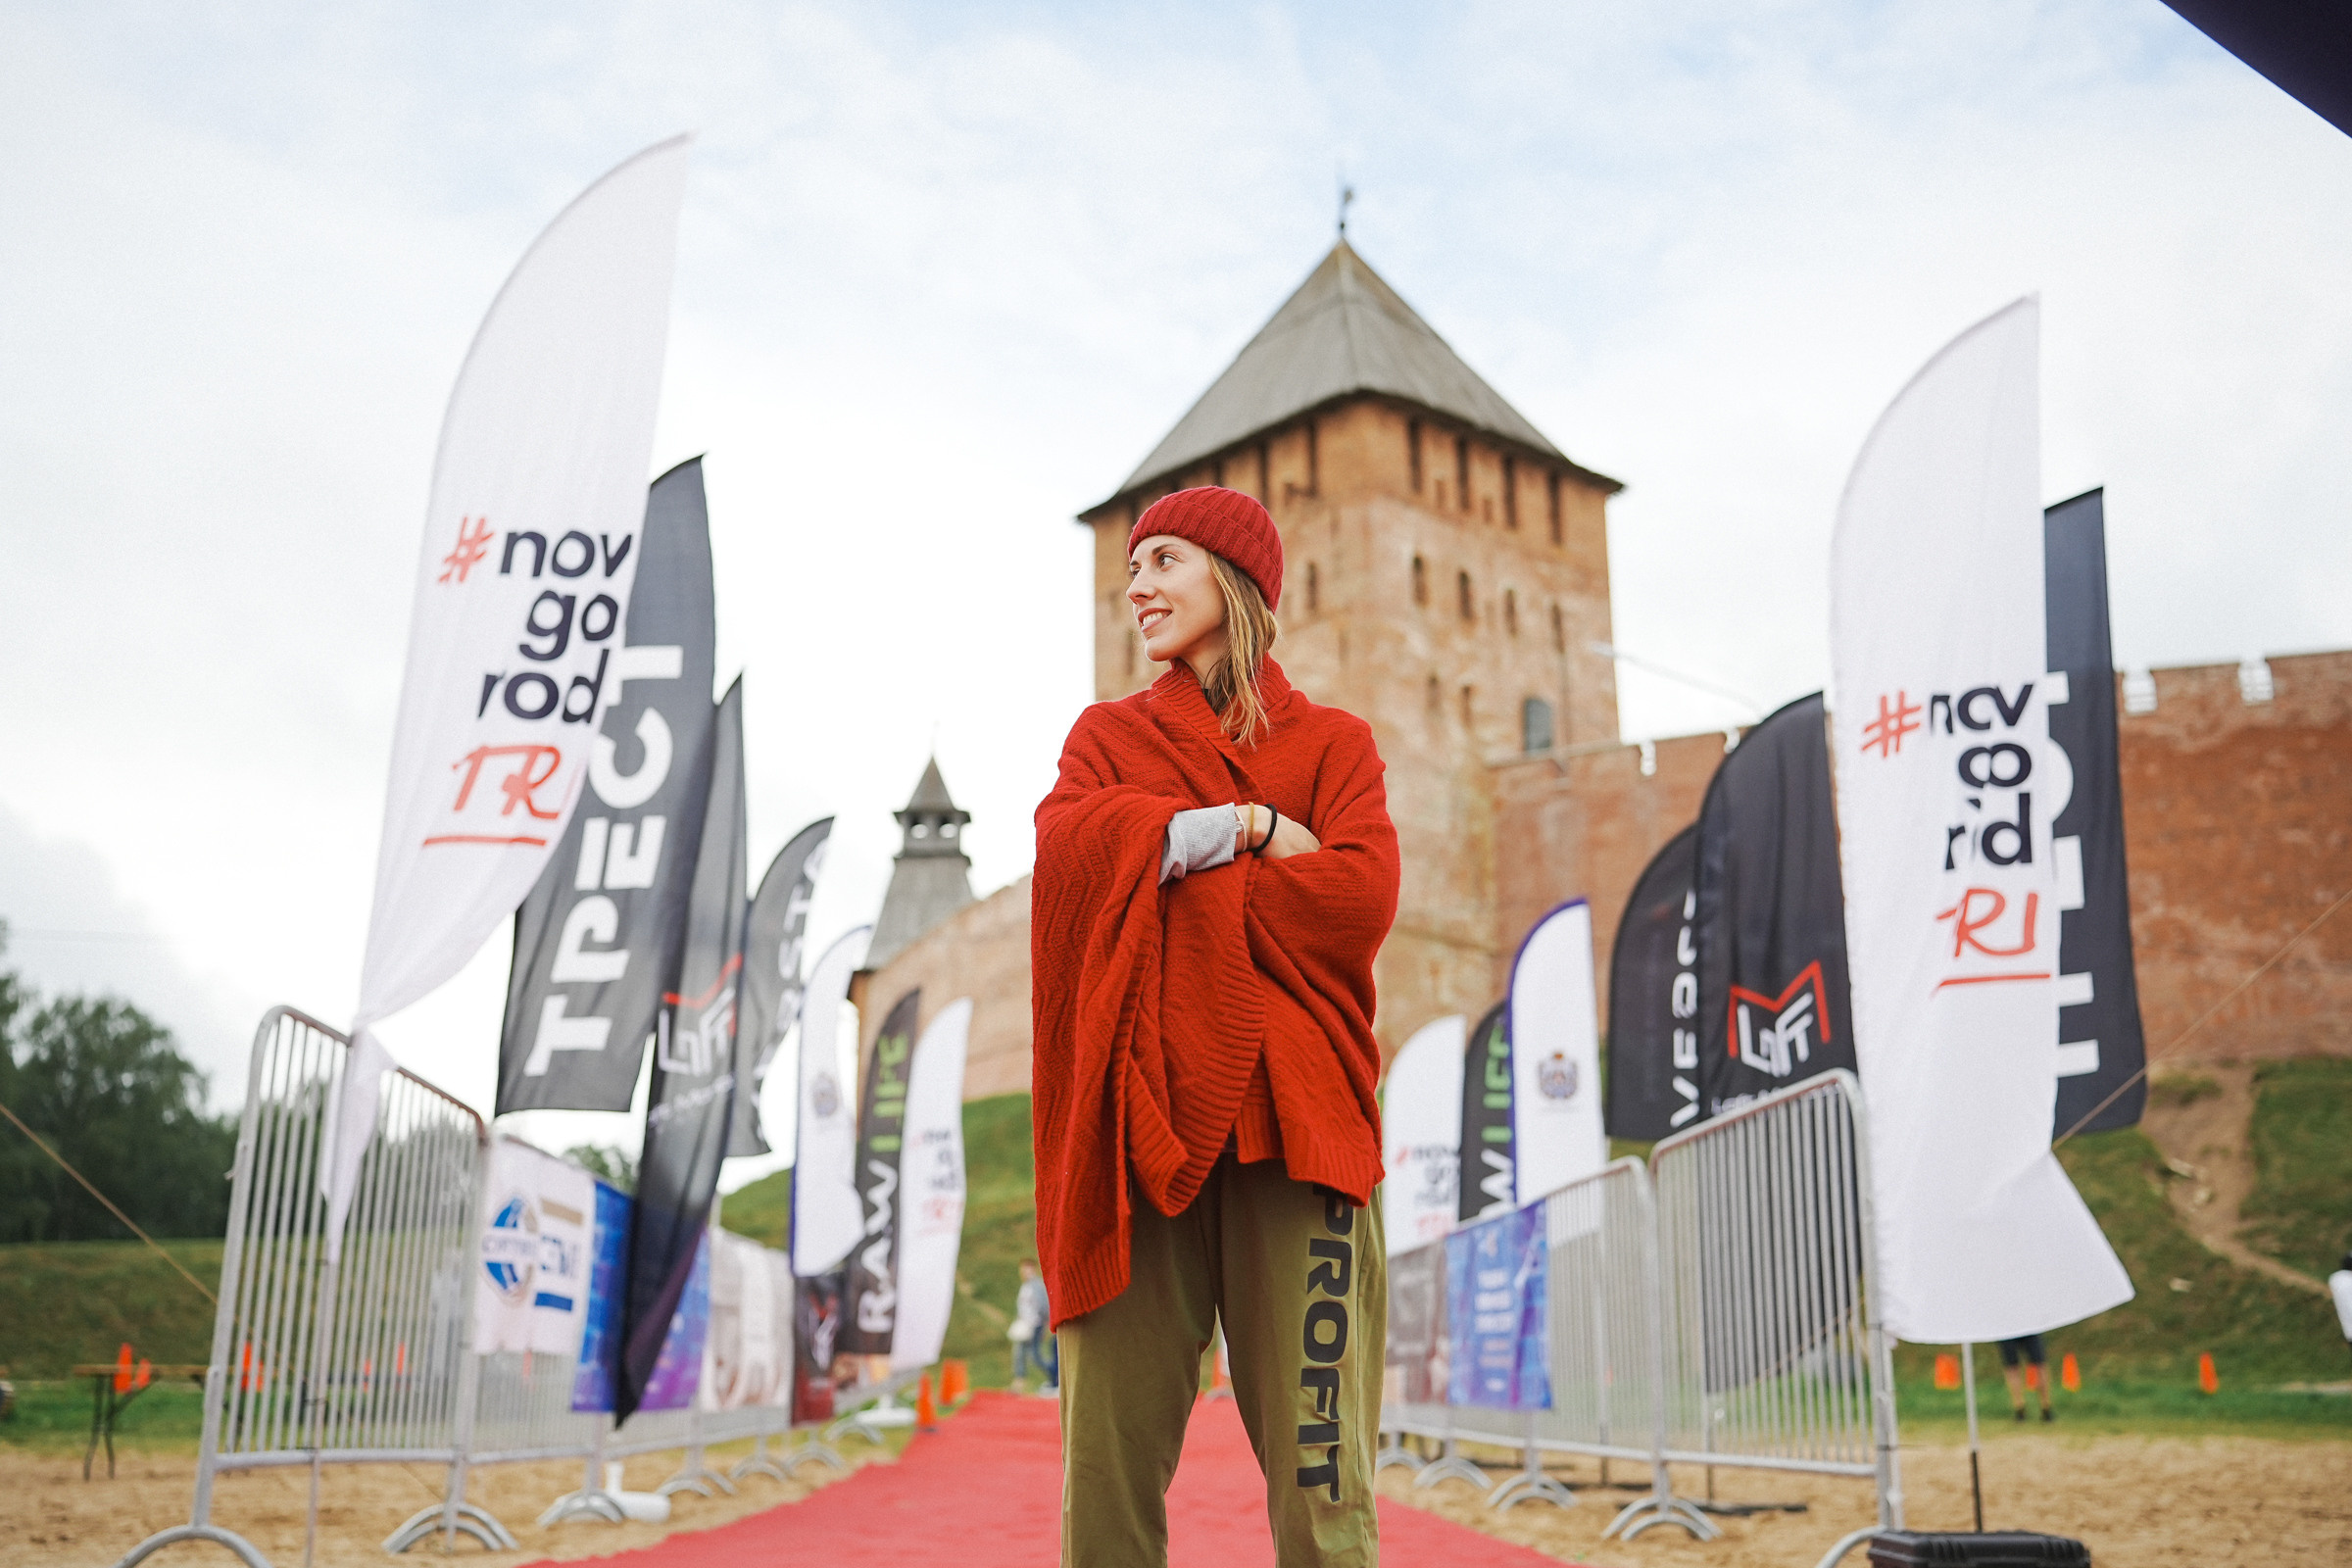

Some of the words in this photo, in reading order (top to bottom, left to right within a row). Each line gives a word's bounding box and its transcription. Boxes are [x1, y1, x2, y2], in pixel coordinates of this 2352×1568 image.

[437, 514, 633, 582] #nov
[518, 589, 619, 662] go
[477, 648, 610, 724] rod
[1945, 792, 2034, 870] rd
[856, 1158, 899, 1334] RAW
[1297, 1183, 1354, 1503] PROFIT
